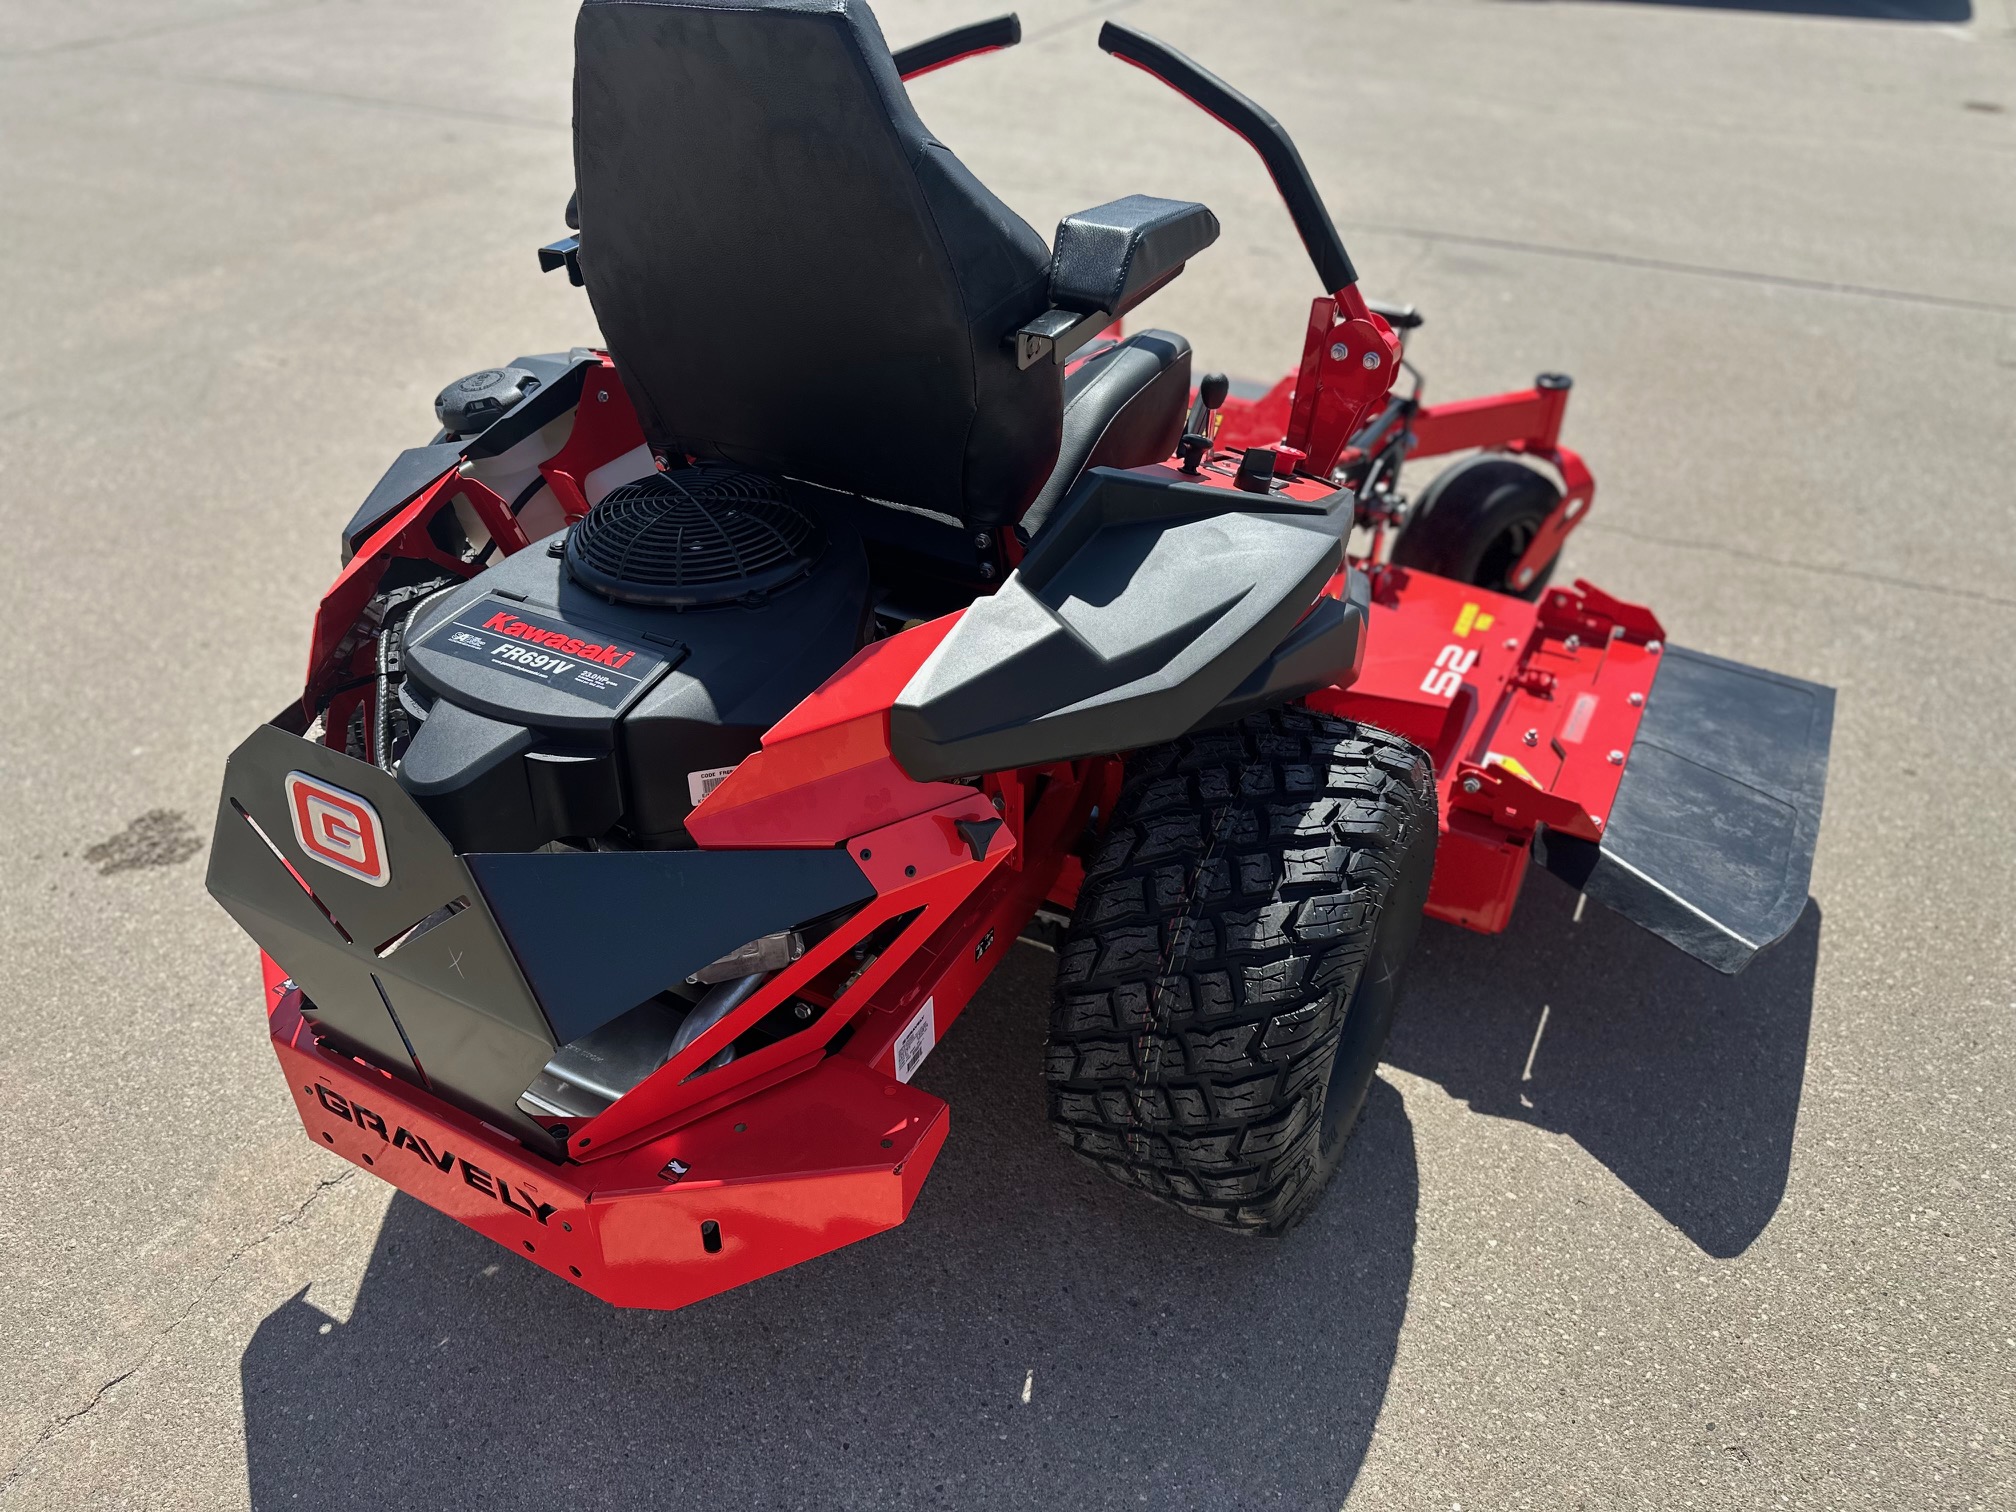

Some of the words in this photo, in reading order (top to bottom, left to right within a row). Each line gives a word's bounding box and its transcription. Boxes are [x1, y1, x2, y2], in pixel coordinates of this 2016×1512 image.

[482, 612, 636, 669] Kawasaki
[490, 643, 576, 674] FR691V
[1419, 643, 1479, 698] 52
[314, 1082, 559, 1227] GRAVELY
